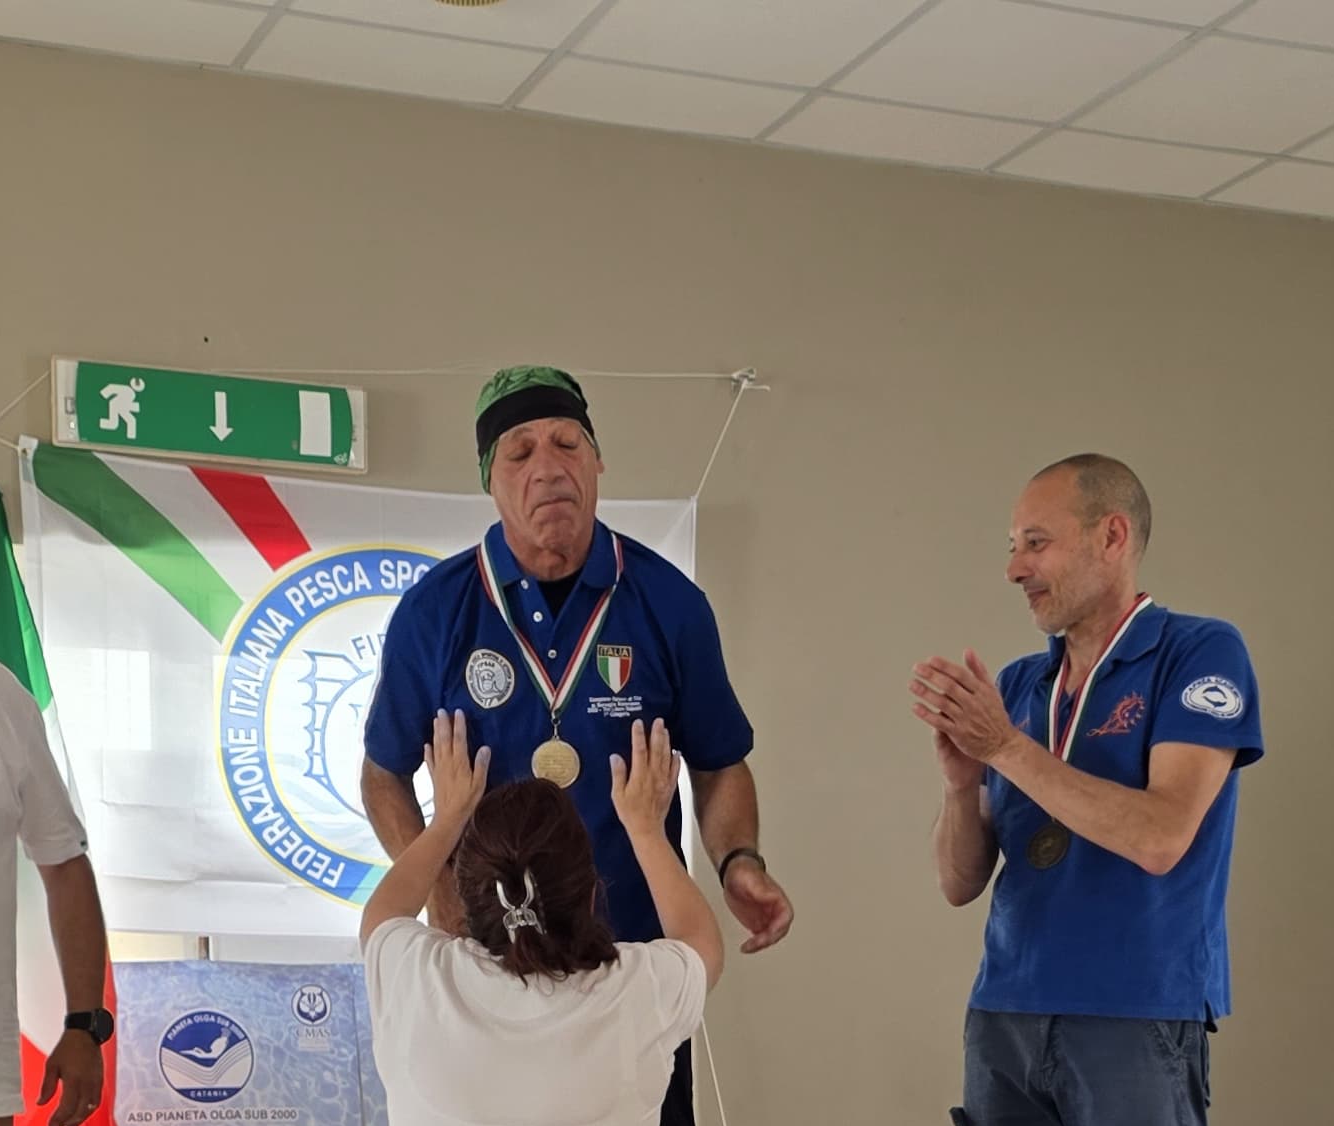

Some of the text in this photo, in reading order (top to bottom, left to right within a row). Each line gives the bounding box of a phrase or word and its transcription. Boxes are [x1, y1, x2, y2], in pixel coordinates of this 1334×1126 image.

[284, 564, 372, 618] PESCA
[599, 646, 630, 657] ITALIA
[228, 606, 294, 719] ITALIANA
[228, 725, 346, 888] FEDERAZIONE
[296, 1027, 331, 1038] CMAS
[190, 1090, 228, 1098] CATANIA
[128, 1109, 297, 1122] ASD PIANETA OLGA SUB 2000
